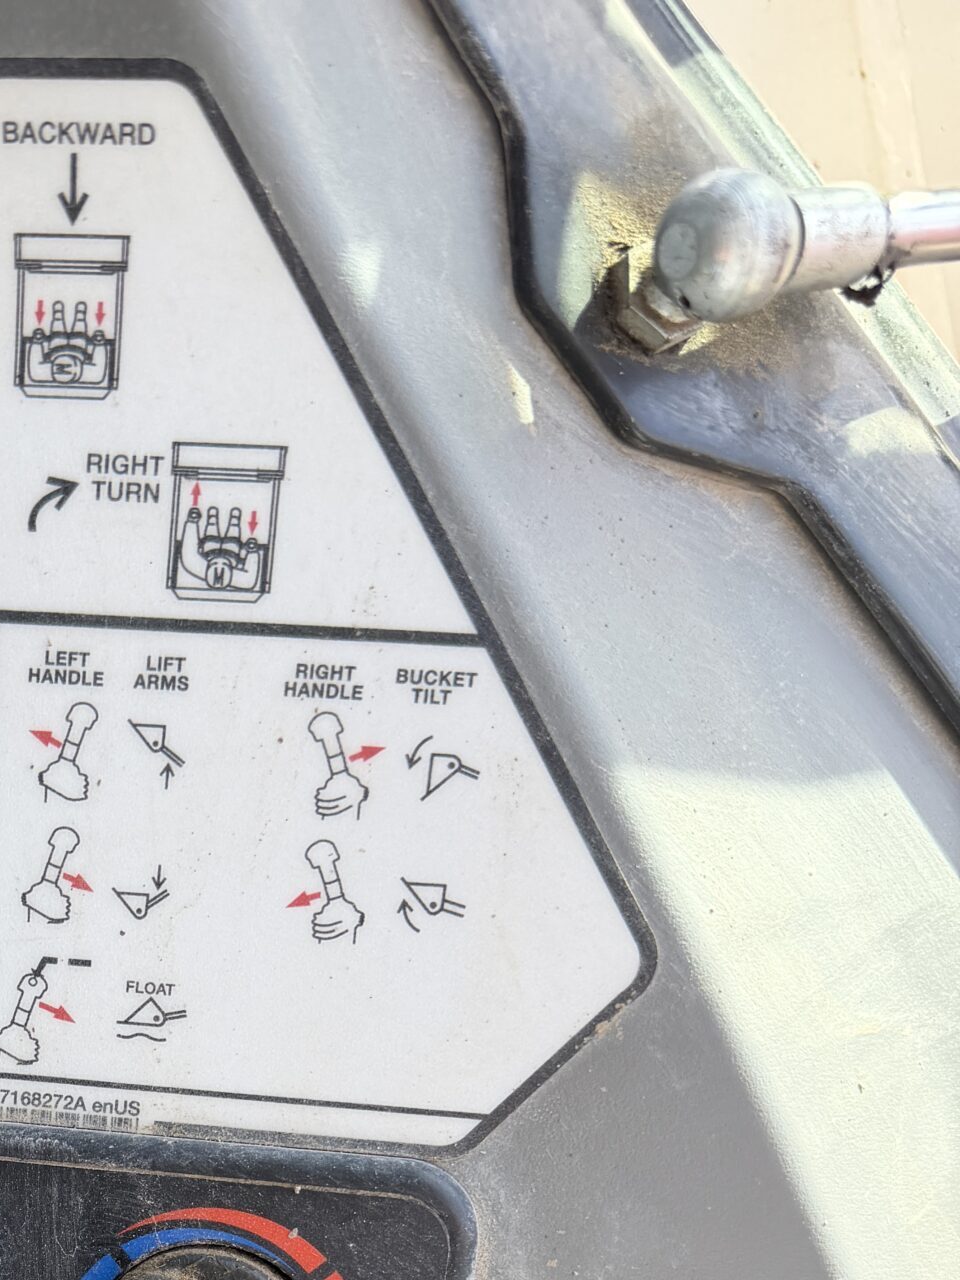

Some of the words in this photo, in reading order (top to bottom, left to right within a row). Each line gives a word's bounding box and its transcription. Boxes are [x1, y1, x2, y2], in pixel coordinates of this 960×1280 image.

[2, 120, 156, 146] BACKWARD
[86, 452, 165, 476] RIGHT
[91, 480, 160, 504] TURN
[44, 649, 91, 668] LEFT
[146, 655, 187, 673] LIFT
[28, 667, 104, 687] HANDLE
[133, 673, 189, 692] ARMS
[295, 663, 357, 682] RIGHT
[395, 668, 478, 691] BUCKET
[284, 681, 364, 701] HANDLE
[411, 687, 453, 705] TILT
[125, 980, 176, 996] FLOAT
[0, 1089, 86, 1112] 7168272A
[91, 1099, 141, 1117] enUS
